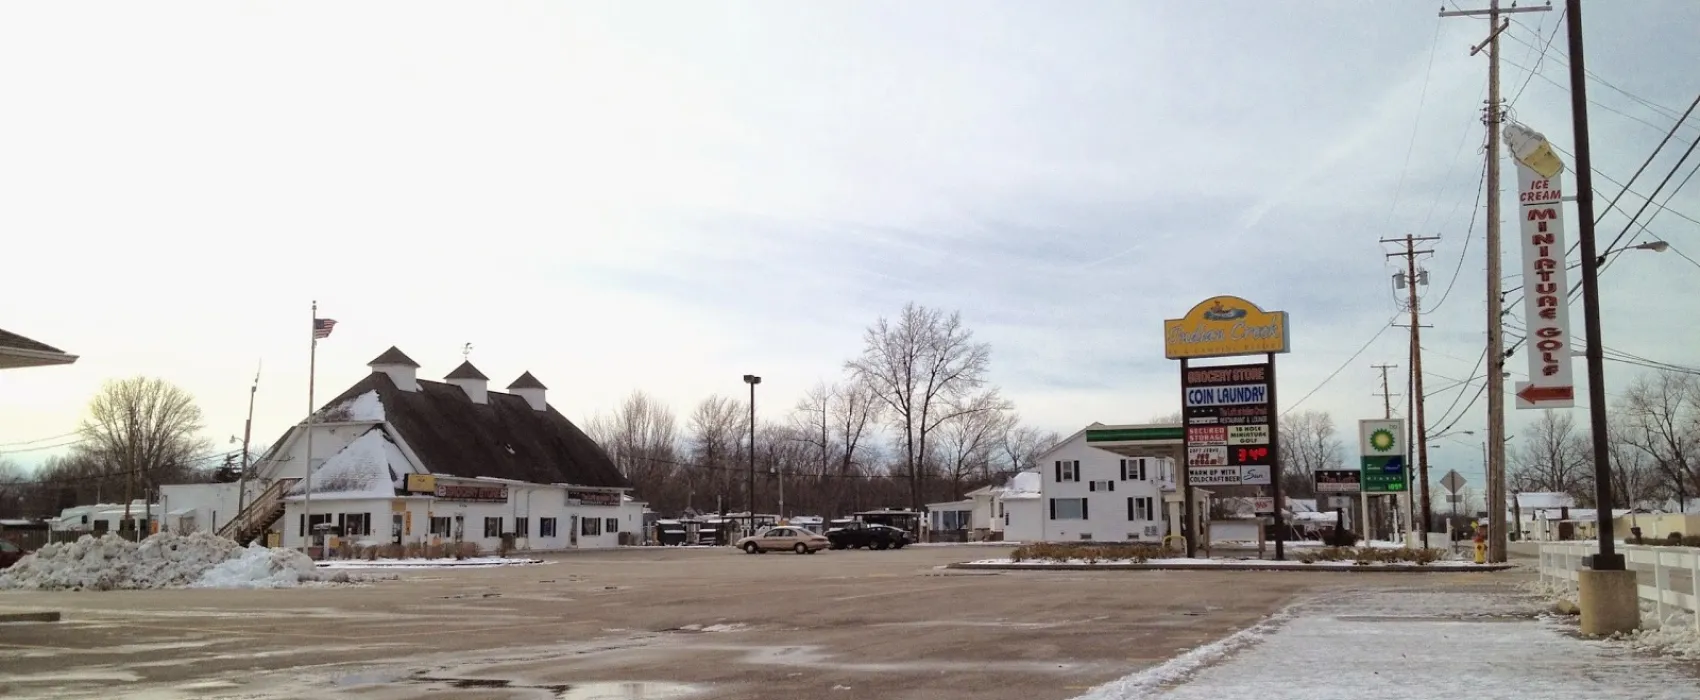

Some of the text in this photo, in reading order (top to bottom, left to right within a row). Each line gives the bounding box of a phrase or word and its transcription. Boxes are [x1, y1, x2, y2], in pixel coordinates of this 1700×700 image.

[1531, 180, 1549, 190] ICE
[1520, 190, 1561, 202] CREAM
[1230, 316, 1279, 341] Creek
[1535, 327, 1563, 376] GOLF
[1187, 367, 1265, 384] GROCERY STORE
[1188, 386, 1265, 405] COIN LAUNDRY
